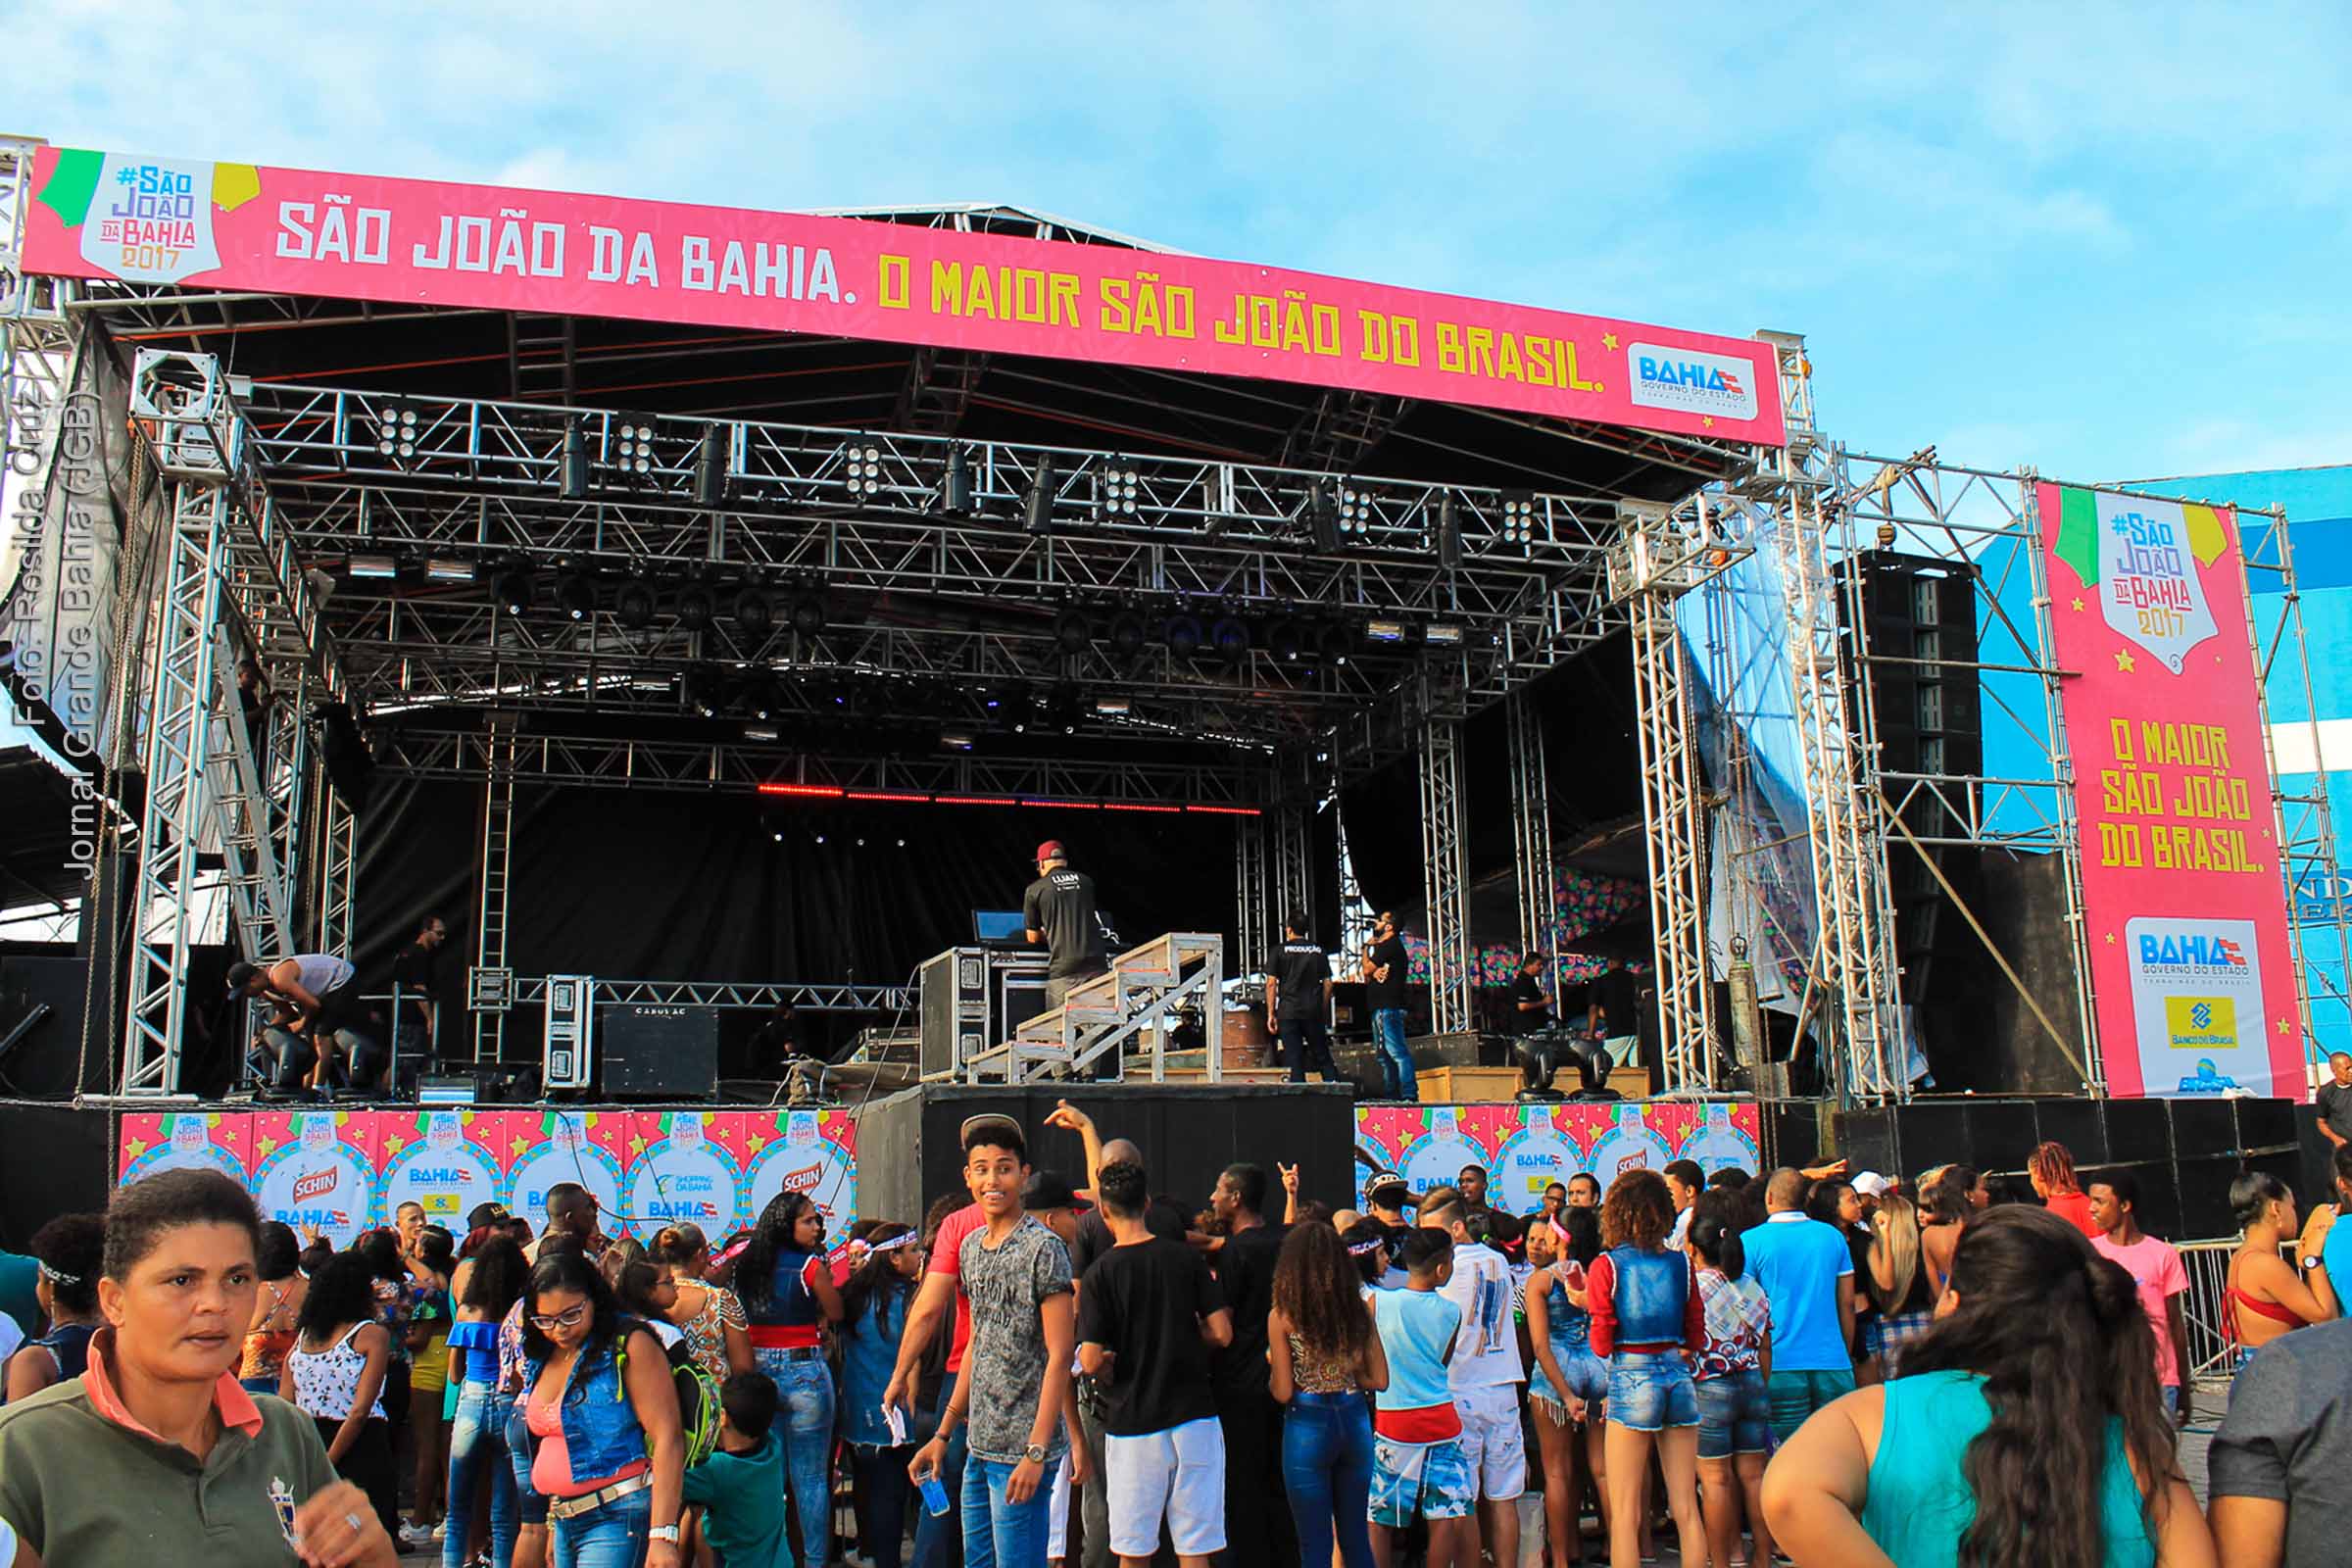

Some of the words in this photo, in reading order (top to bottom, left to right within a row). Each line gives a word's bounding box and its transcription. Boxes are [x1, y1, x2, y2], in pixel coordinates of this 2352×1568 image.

[117, 166, 192, 194] #SÃO
[112, 187, 194, 220] JOÃO
[100, 222, 120, 239] DA
[123, 220, 195, 247] BAHIA
[122, 246, 180, 270] 2017
[275, 194, 391, 264] SÃO
[413, 208, 565, 277] JOÃO
[588, 225, 660, 287] DA
[682, 235, 857, 304] BAHIA.
[879, 254, 909, 309] O
[931, 260, 1081, 328] MAIOR
[1100, 271, 1196, 339] SÃO
[1215, 289, 1342, 356] JOÃO
[1358, 310, 1420, 367] DO
[1437, 320, 1604, 392] BRASIL.
[1639, 357, 1729, 391] BAHIA
[1641, 380, 1688, 394] GOVERNO
[1709, 390, 1746, 402] ESTADO
[2111, 513, 2173, 547] #SÃO
[2117, 538, 2180, 576] JOÃO
[2115, 581, 2132, 602] DA
[2133, 576, 2192, 611] BAHIA
[2139, 608, 2184, 638] 2017
[2110, 717, 2134, 761] O
[2141, 721, 2231, 769] MAIOR
[2100, 763, 2164, 816] SÃO
[2174, 769, 2250, 821] JOÃO
[2098, 822, 2142, 867] DO
[2151, 824, 2264, 873] BRASIL.
[2139, 934, 2231, 965] BAHIA
[2142, 964, 2190, 975] GOVERNO
[2194, 964, 2209, 975] DO
[2212, 965, 2249, 977] ESTADO
[1516, 1154, 1553, 1166] BAHIA
[1618, 1155, 1646, 1175] SCHIN
[295, 1174, 336, 1198] SCHIN
[410, 1168, 460, 1182] BAHIA
[784, 1169, 820, 1193] SCHIN
[274, 1209, 337, 1225] BAHIA
[648, 1201, 706, 1216] BAHIA
